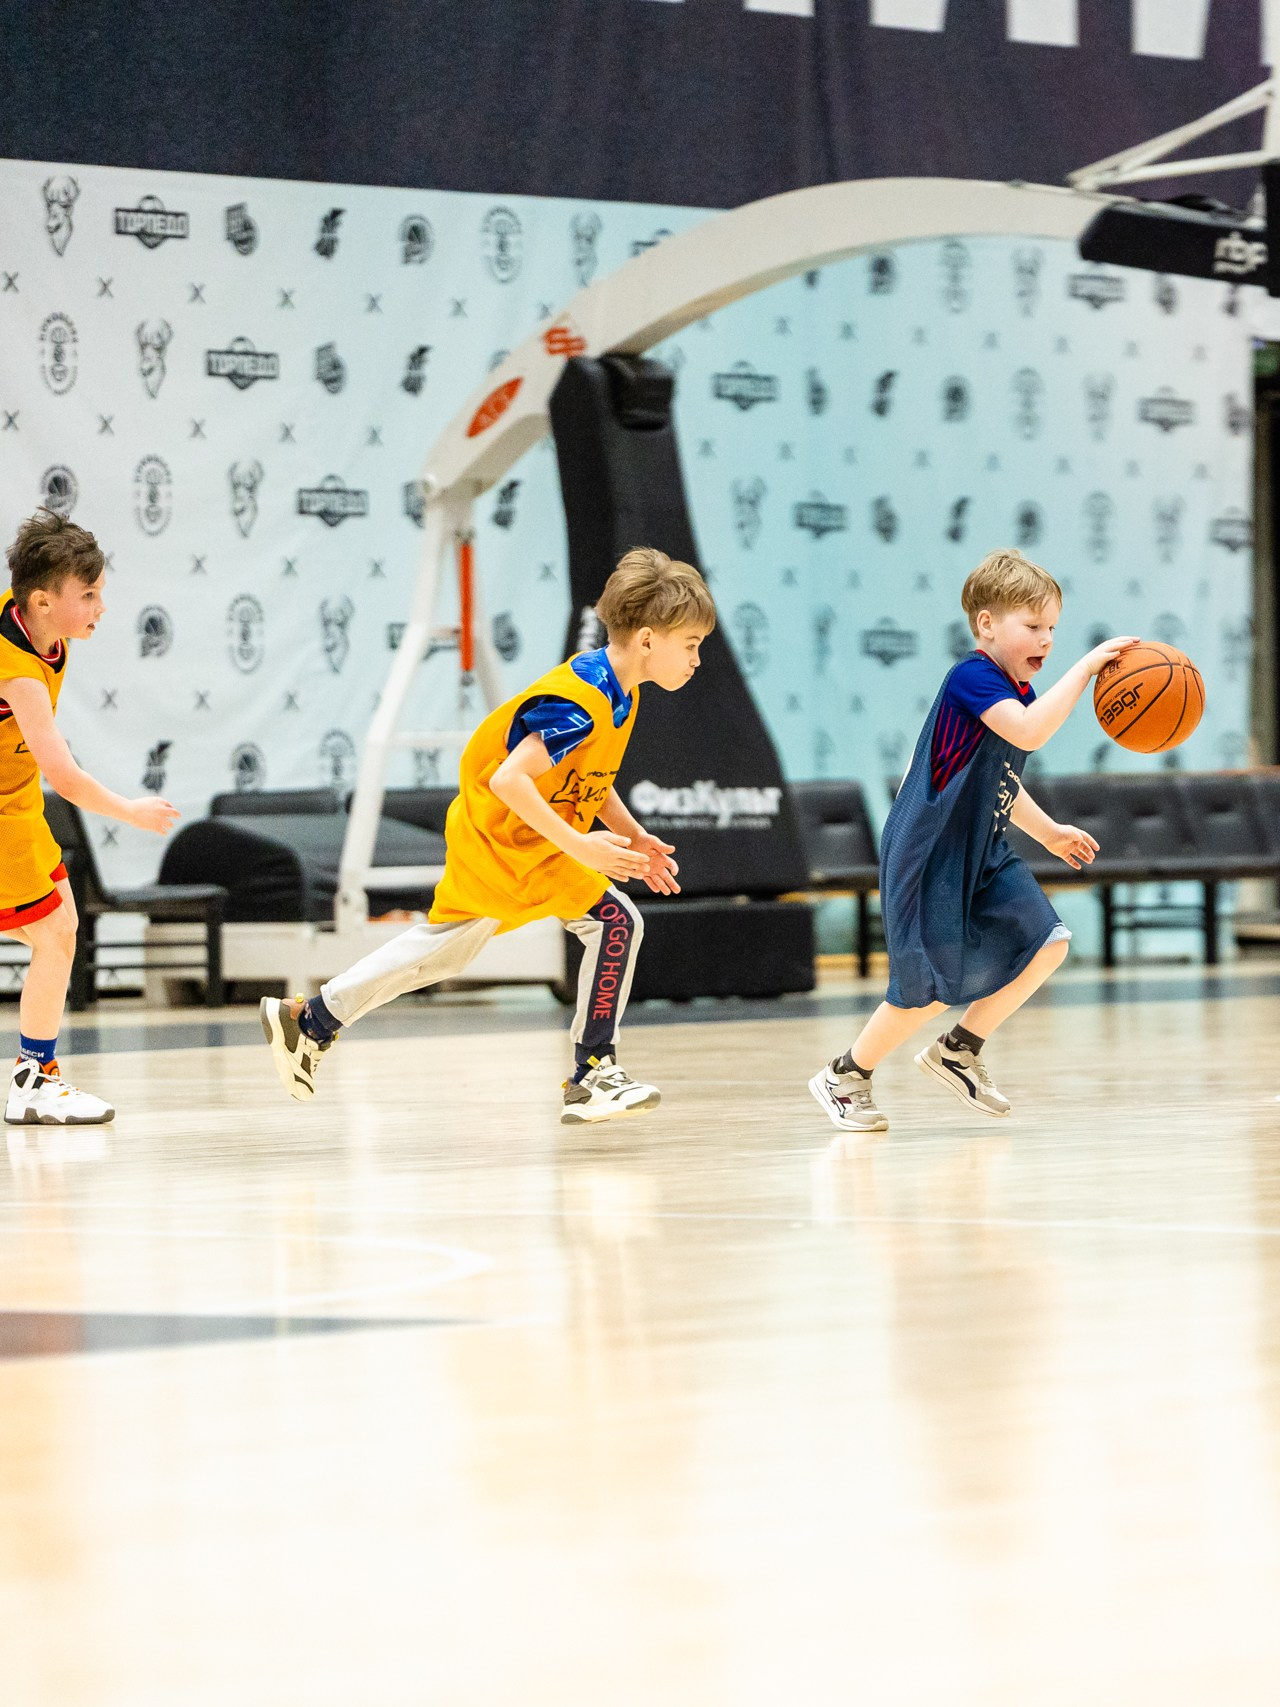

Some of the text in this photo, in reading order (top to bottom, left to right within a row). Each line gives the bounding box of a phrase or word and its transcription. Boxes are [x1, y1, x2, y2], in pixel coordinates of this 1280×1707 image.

[1100, 682, 1144, 727] JÖGEL
[605, 926, 629, 957] GO
[592, 962, 621, 1020] HOME
